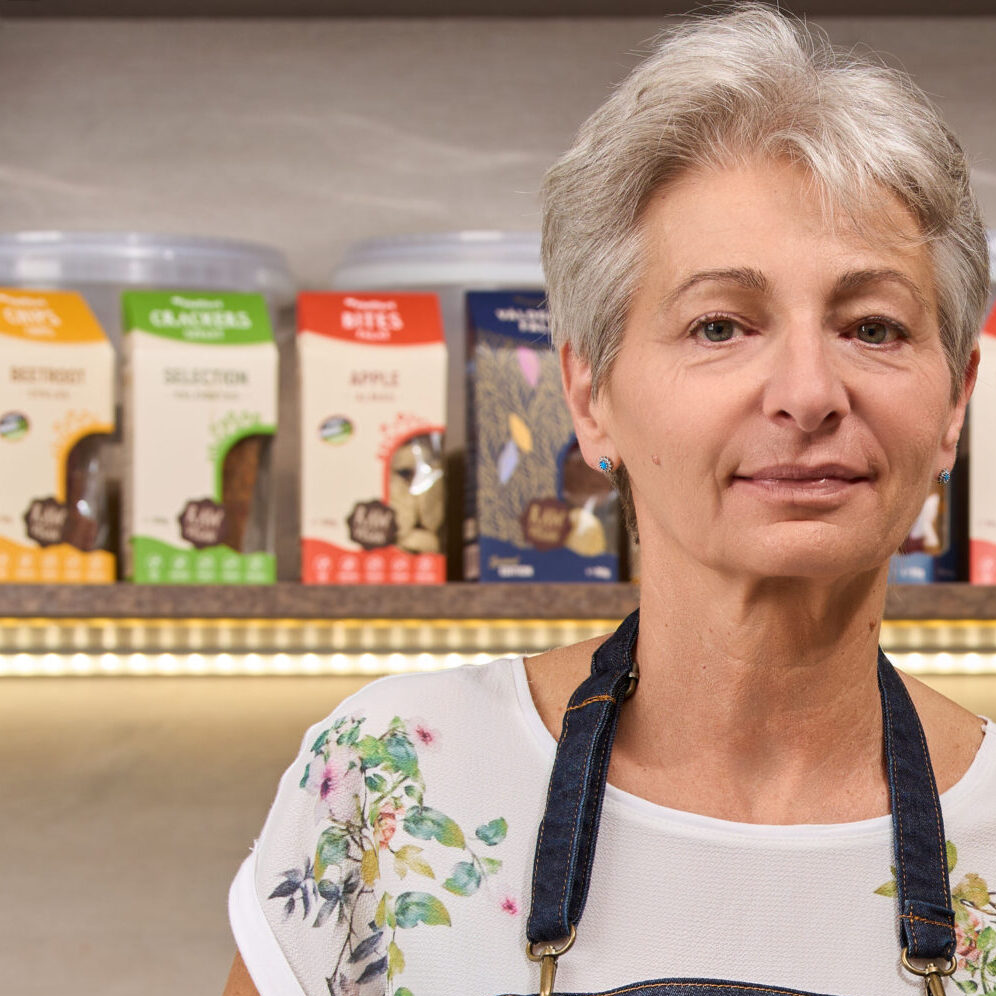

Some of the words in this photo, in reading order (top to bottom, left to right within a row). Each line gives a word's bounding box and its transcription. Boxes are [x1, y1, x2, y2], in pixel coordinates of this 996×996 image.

[149, 308, 252, 328] CRACKERS
[341, 311, 404, 331] BITES
[9, 365, 86, 384] BEETROOT
[164, 368, 249, 385] SELECTION
[350, 369, 399, 388] APPLE
